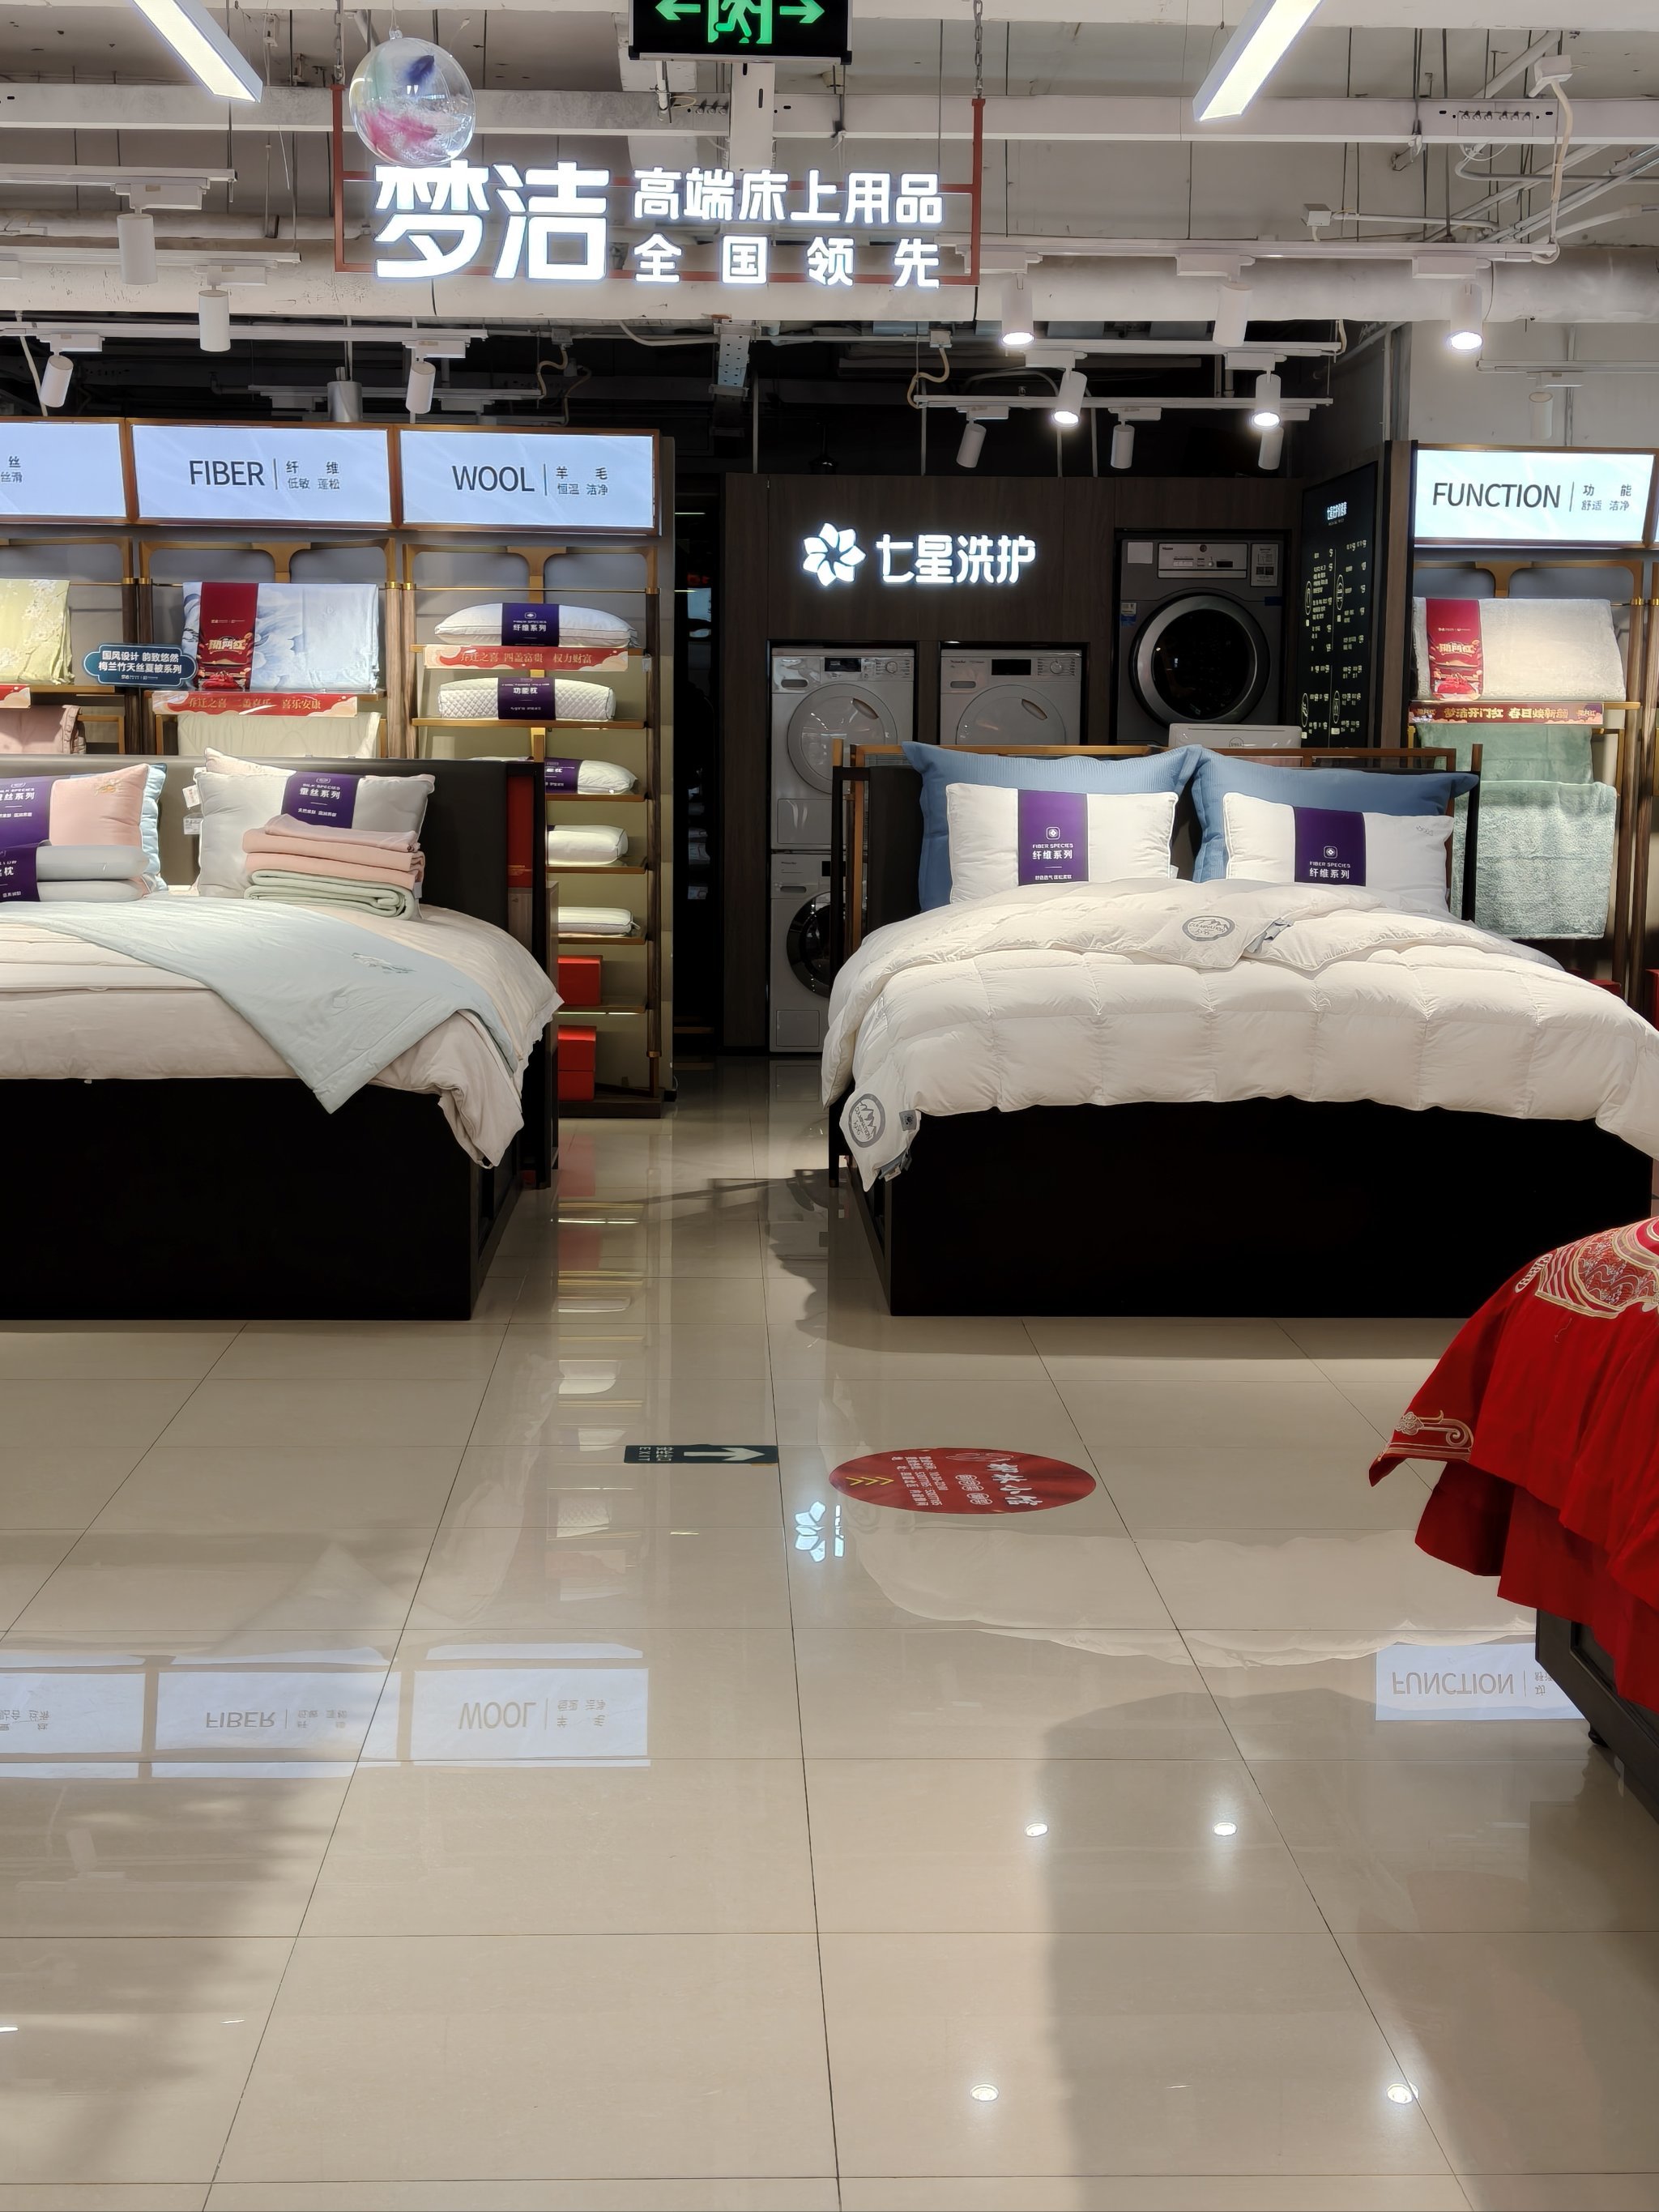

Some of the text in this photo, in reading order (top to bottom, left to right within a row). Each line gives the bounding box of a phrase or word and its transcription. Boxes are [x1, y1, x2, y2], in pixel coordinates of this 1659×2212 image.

[633, 166, 944, 224] 高端床上用品
[375, 160, 610, 281] 梦洁
[633, 232, 941, 289] 全国领先
[190, 460, 265, 486] FIBER
[286, 461, 339, 475] 纤维
[556, 466, 608, 479] 羊毛
[452, 466, 535, 492] WOOL
[1432, 482, 1561, 508] FUNCTION
[1582, 484, 1631, 497] 功能
[1580, 500, 1630, 511] 舒适 洁净
[875, 533, 1036, 584] 七星洗护
[102, 650, 139, 660] 国风设计
[1032, 850, 1073, 859] 纤维系列
[1309, 867, 1350, 880] 纤维系列
[638, 1447, 650, 1461] EXIT
